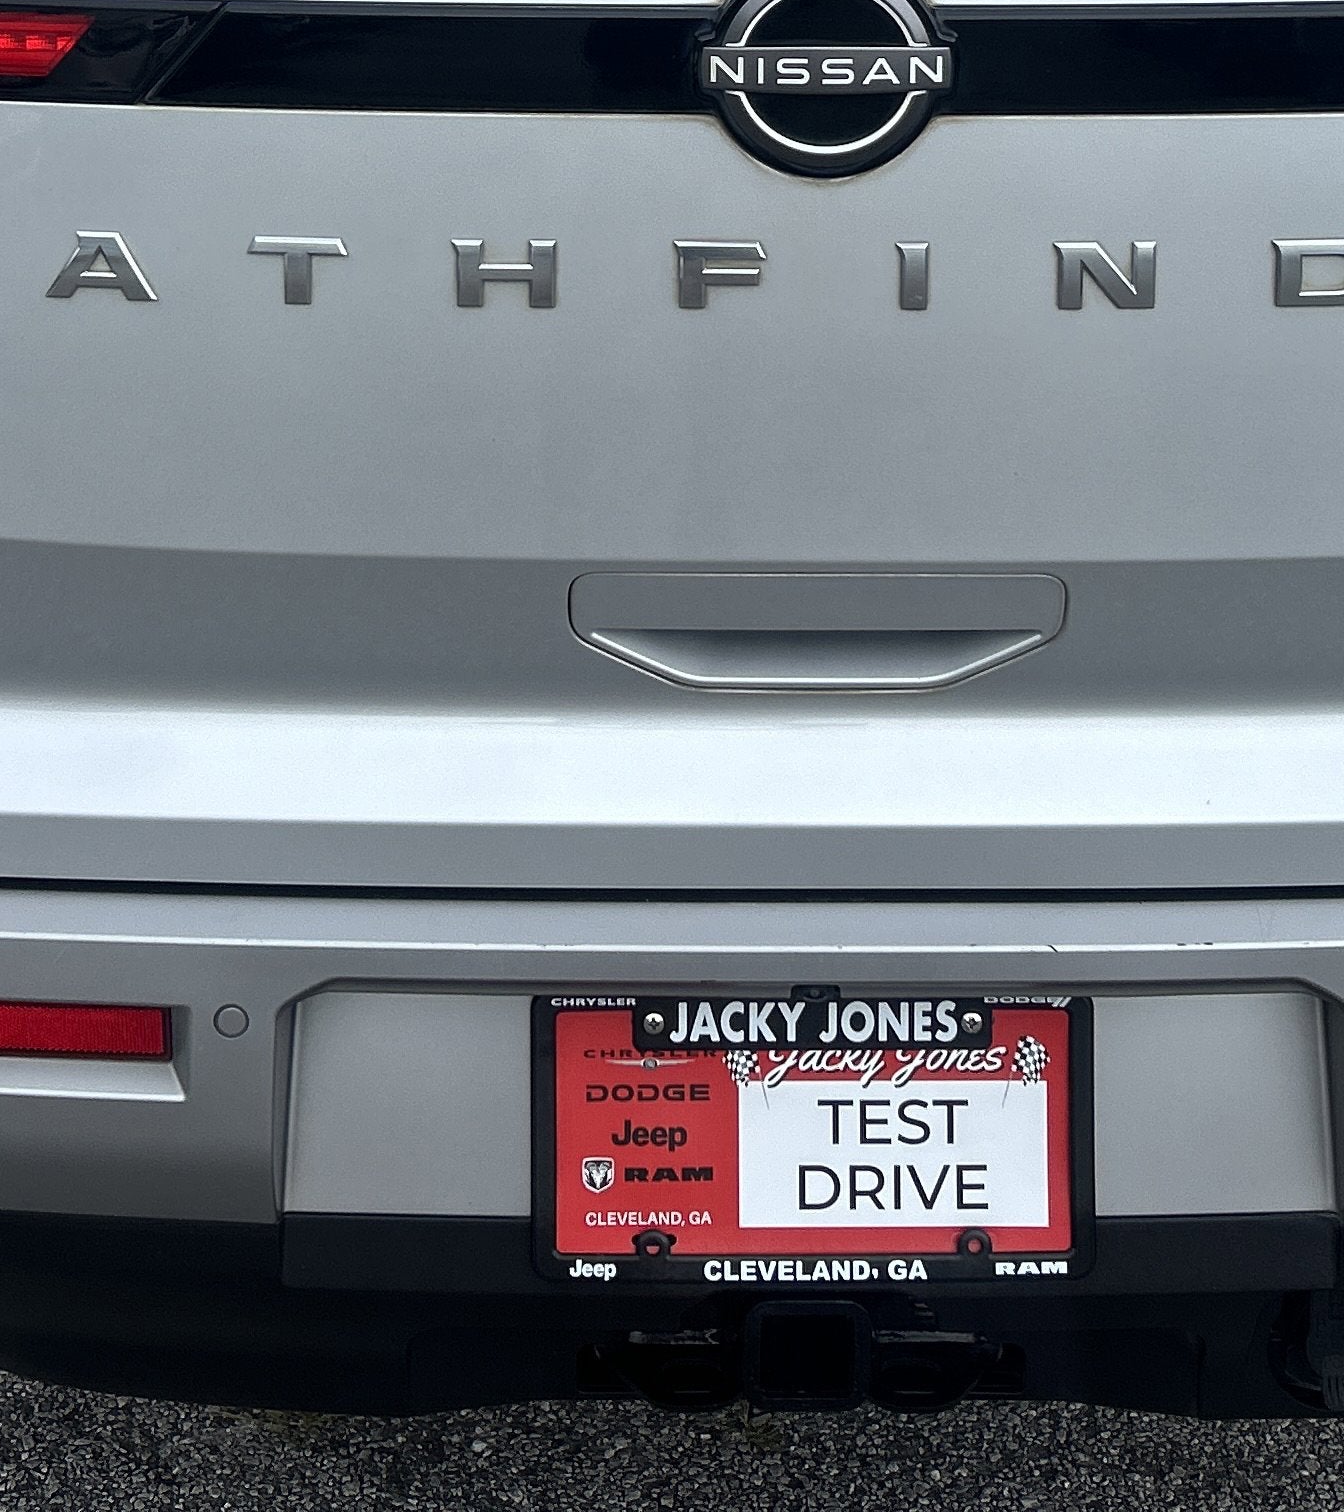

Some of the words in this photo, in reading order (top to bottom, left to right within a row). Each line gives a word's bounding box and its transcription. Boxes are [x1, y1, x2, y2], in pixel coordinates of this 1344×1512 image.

[709, 55, 944, 85] NISSAN
[550, 997, 637, 1007] CHRYSLER
[669, 1000, 806, 1043] JACKY
[818, 999, 958, 1043] JONES
[585, 1083, 711, 1102] DODGE
[816, 1099, 969, 1145] TEST
[611, 1119, 688, 1152] Jeep
[624, 1166, 714, 1182] RAM
[798, 1164, 989, 1210] DRIVE
[585, 1211, 686, 1227] CLEVELAND,
[689, 1210, 713, 1226] GA
[569, 1258, 617, 1281] Jeep
[703, 1259, 879, 1282] CLEVELAND,
[887, 1259, 929, 1281] GA
[994, 1261, 1068, 1275] RAM
